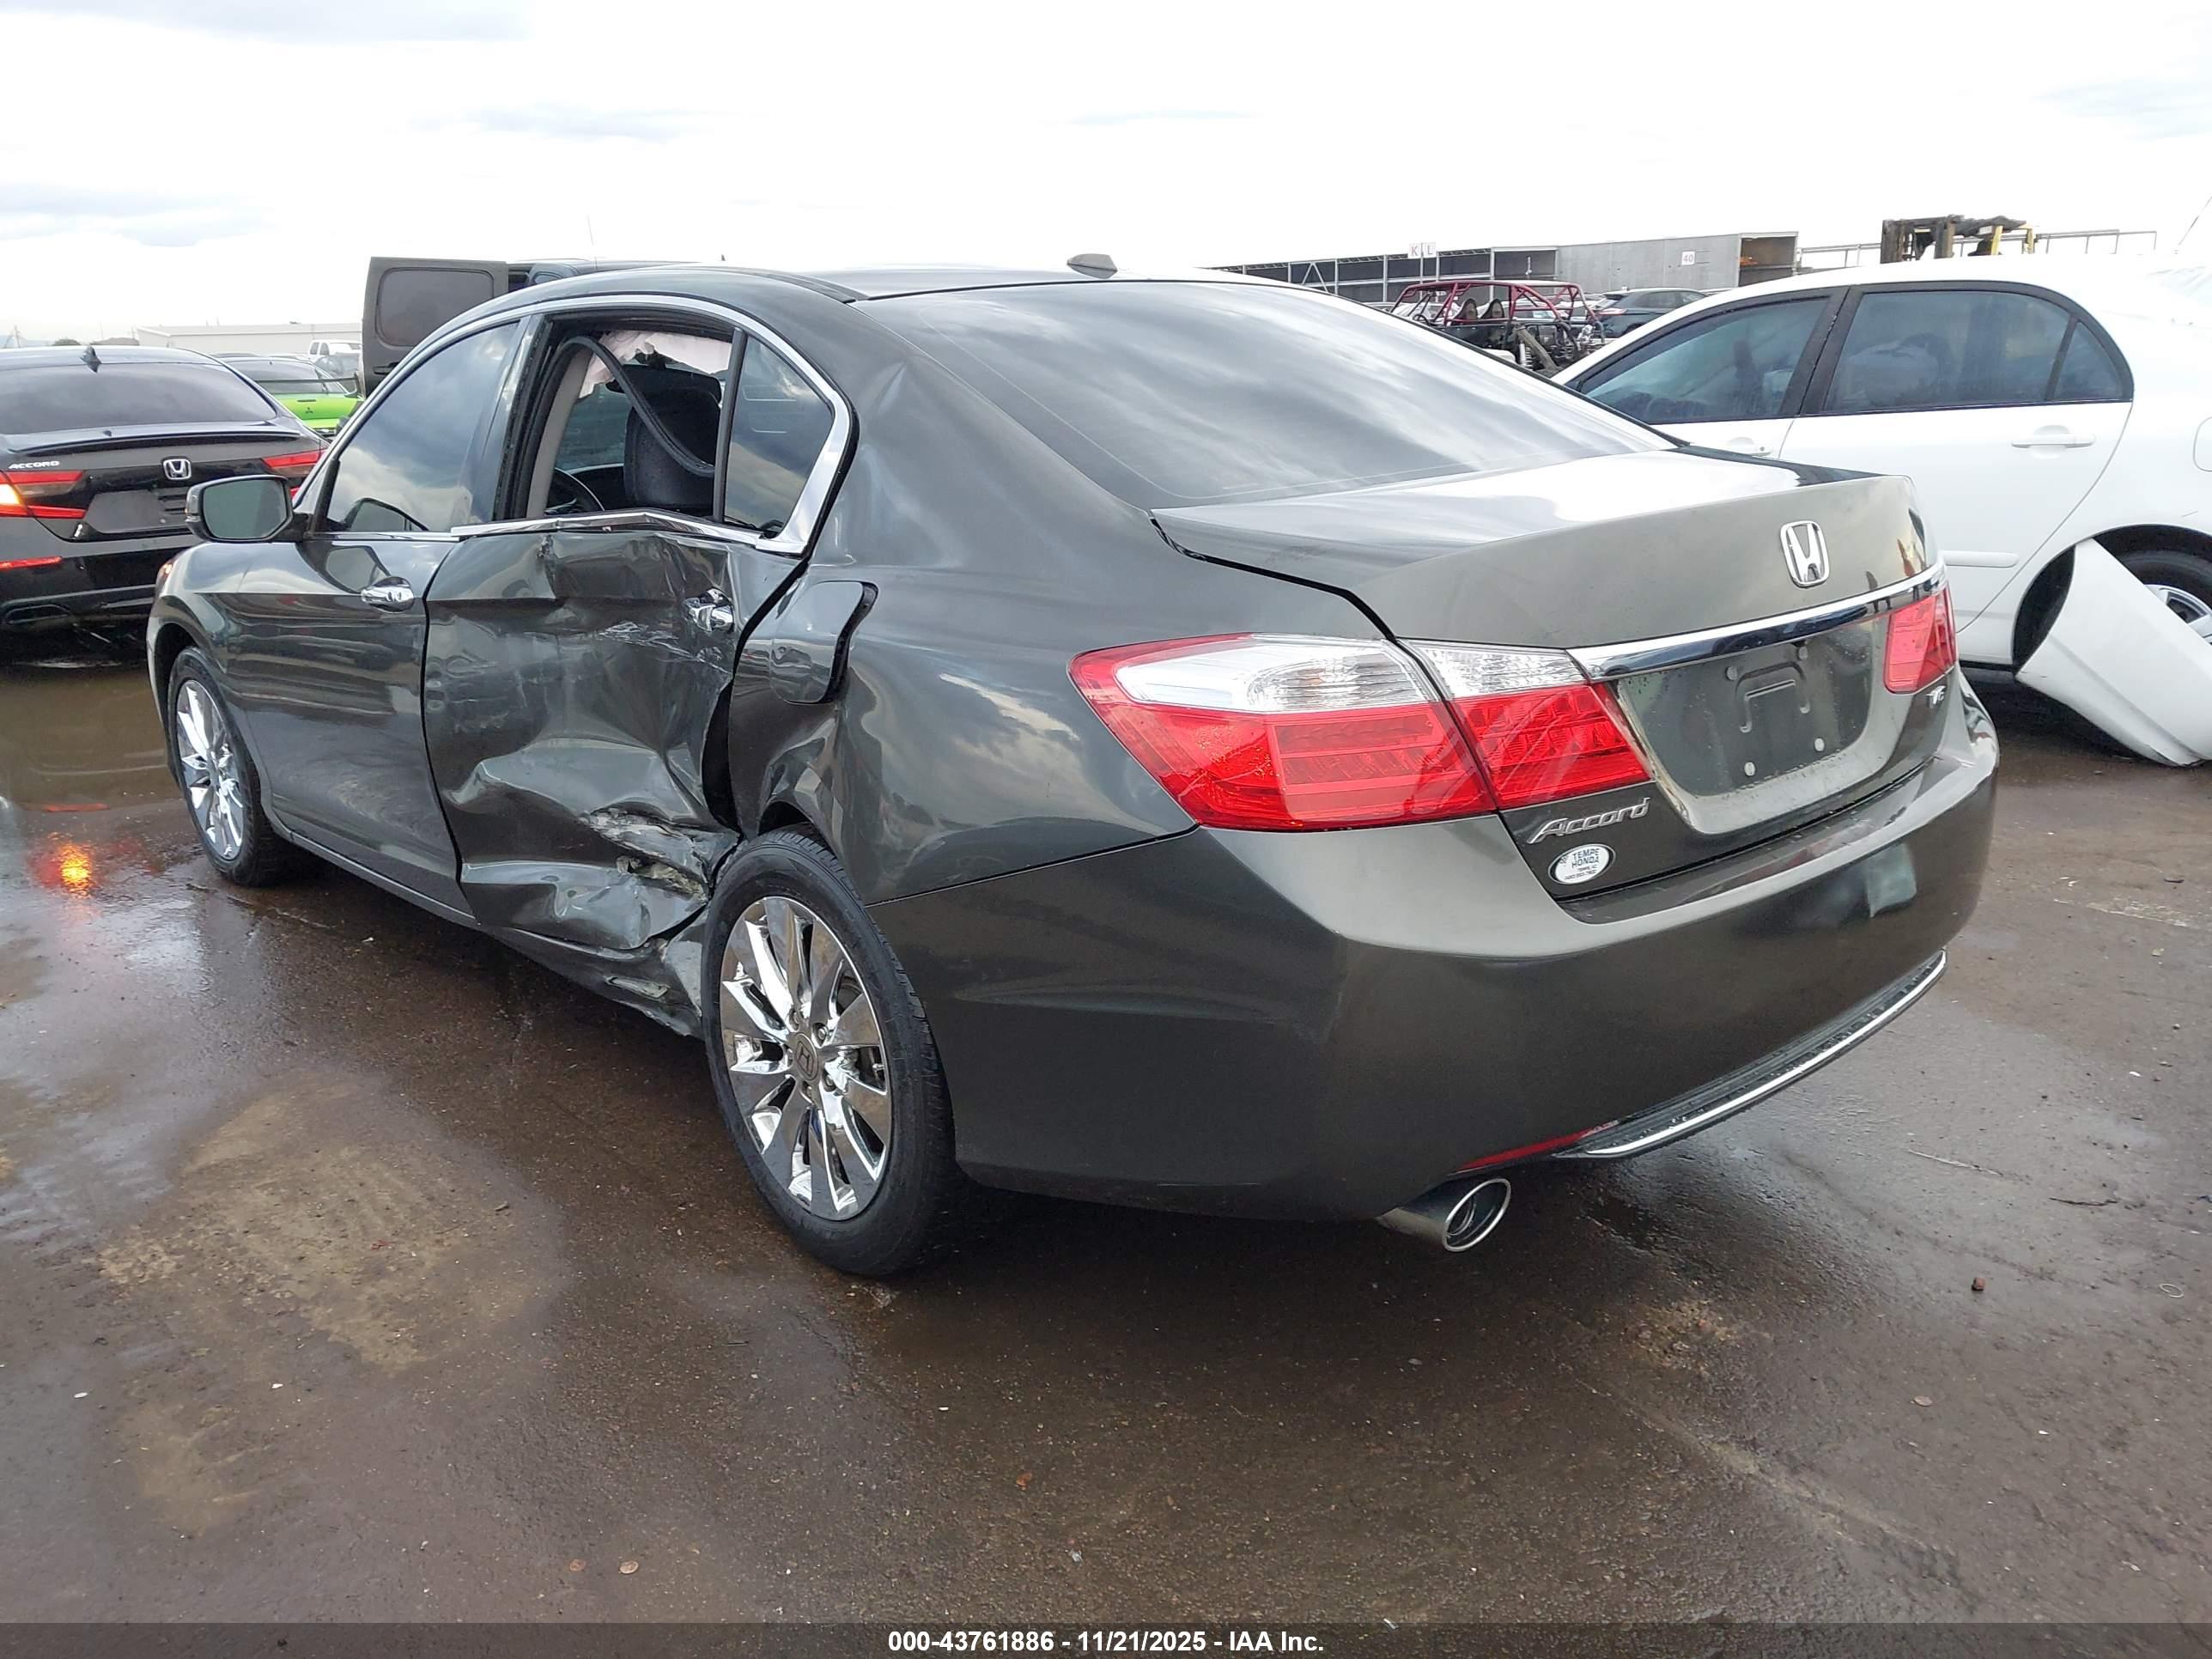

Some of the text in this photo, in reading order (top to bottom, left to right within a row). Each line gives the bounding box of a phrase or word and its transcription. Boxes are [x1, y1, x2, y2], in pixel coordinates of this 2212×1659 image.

[1683, 253, 1693, 263] 40
[8, 460, 60, 469] ACCORD
[1527, 797, 1650, 843] Accord
[1572, 848, 1600, 861] TEMPE
[1571, 856, 1600, 869] HONDA
